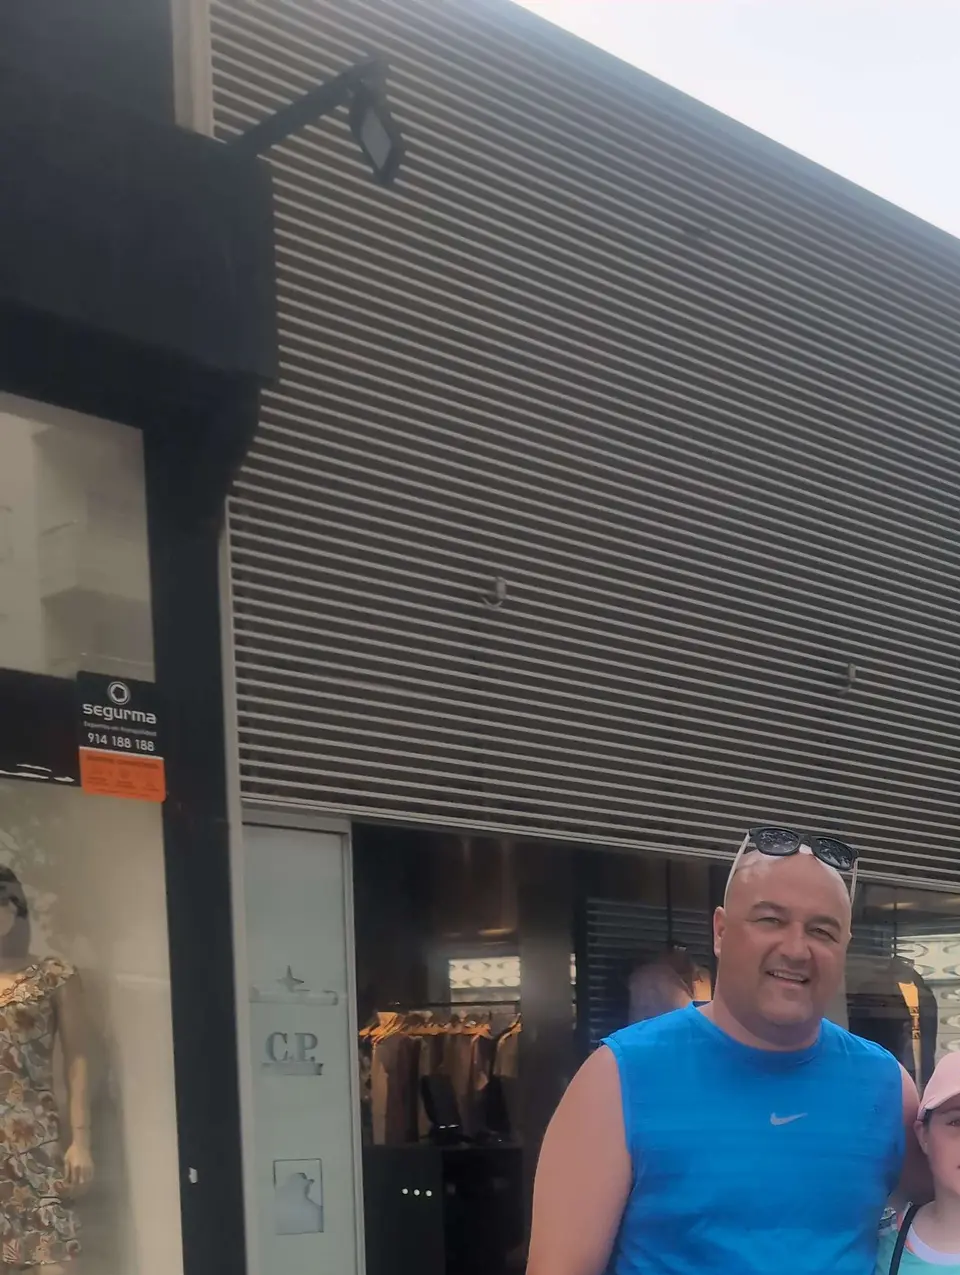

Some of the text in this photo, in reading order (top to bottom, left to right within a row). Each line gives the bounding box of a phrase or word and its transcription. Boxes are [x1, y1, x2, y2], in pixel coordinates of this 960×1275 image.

[82, 703, 157, 724] segurma
[87, 732, 155, 752] 914 188 188
